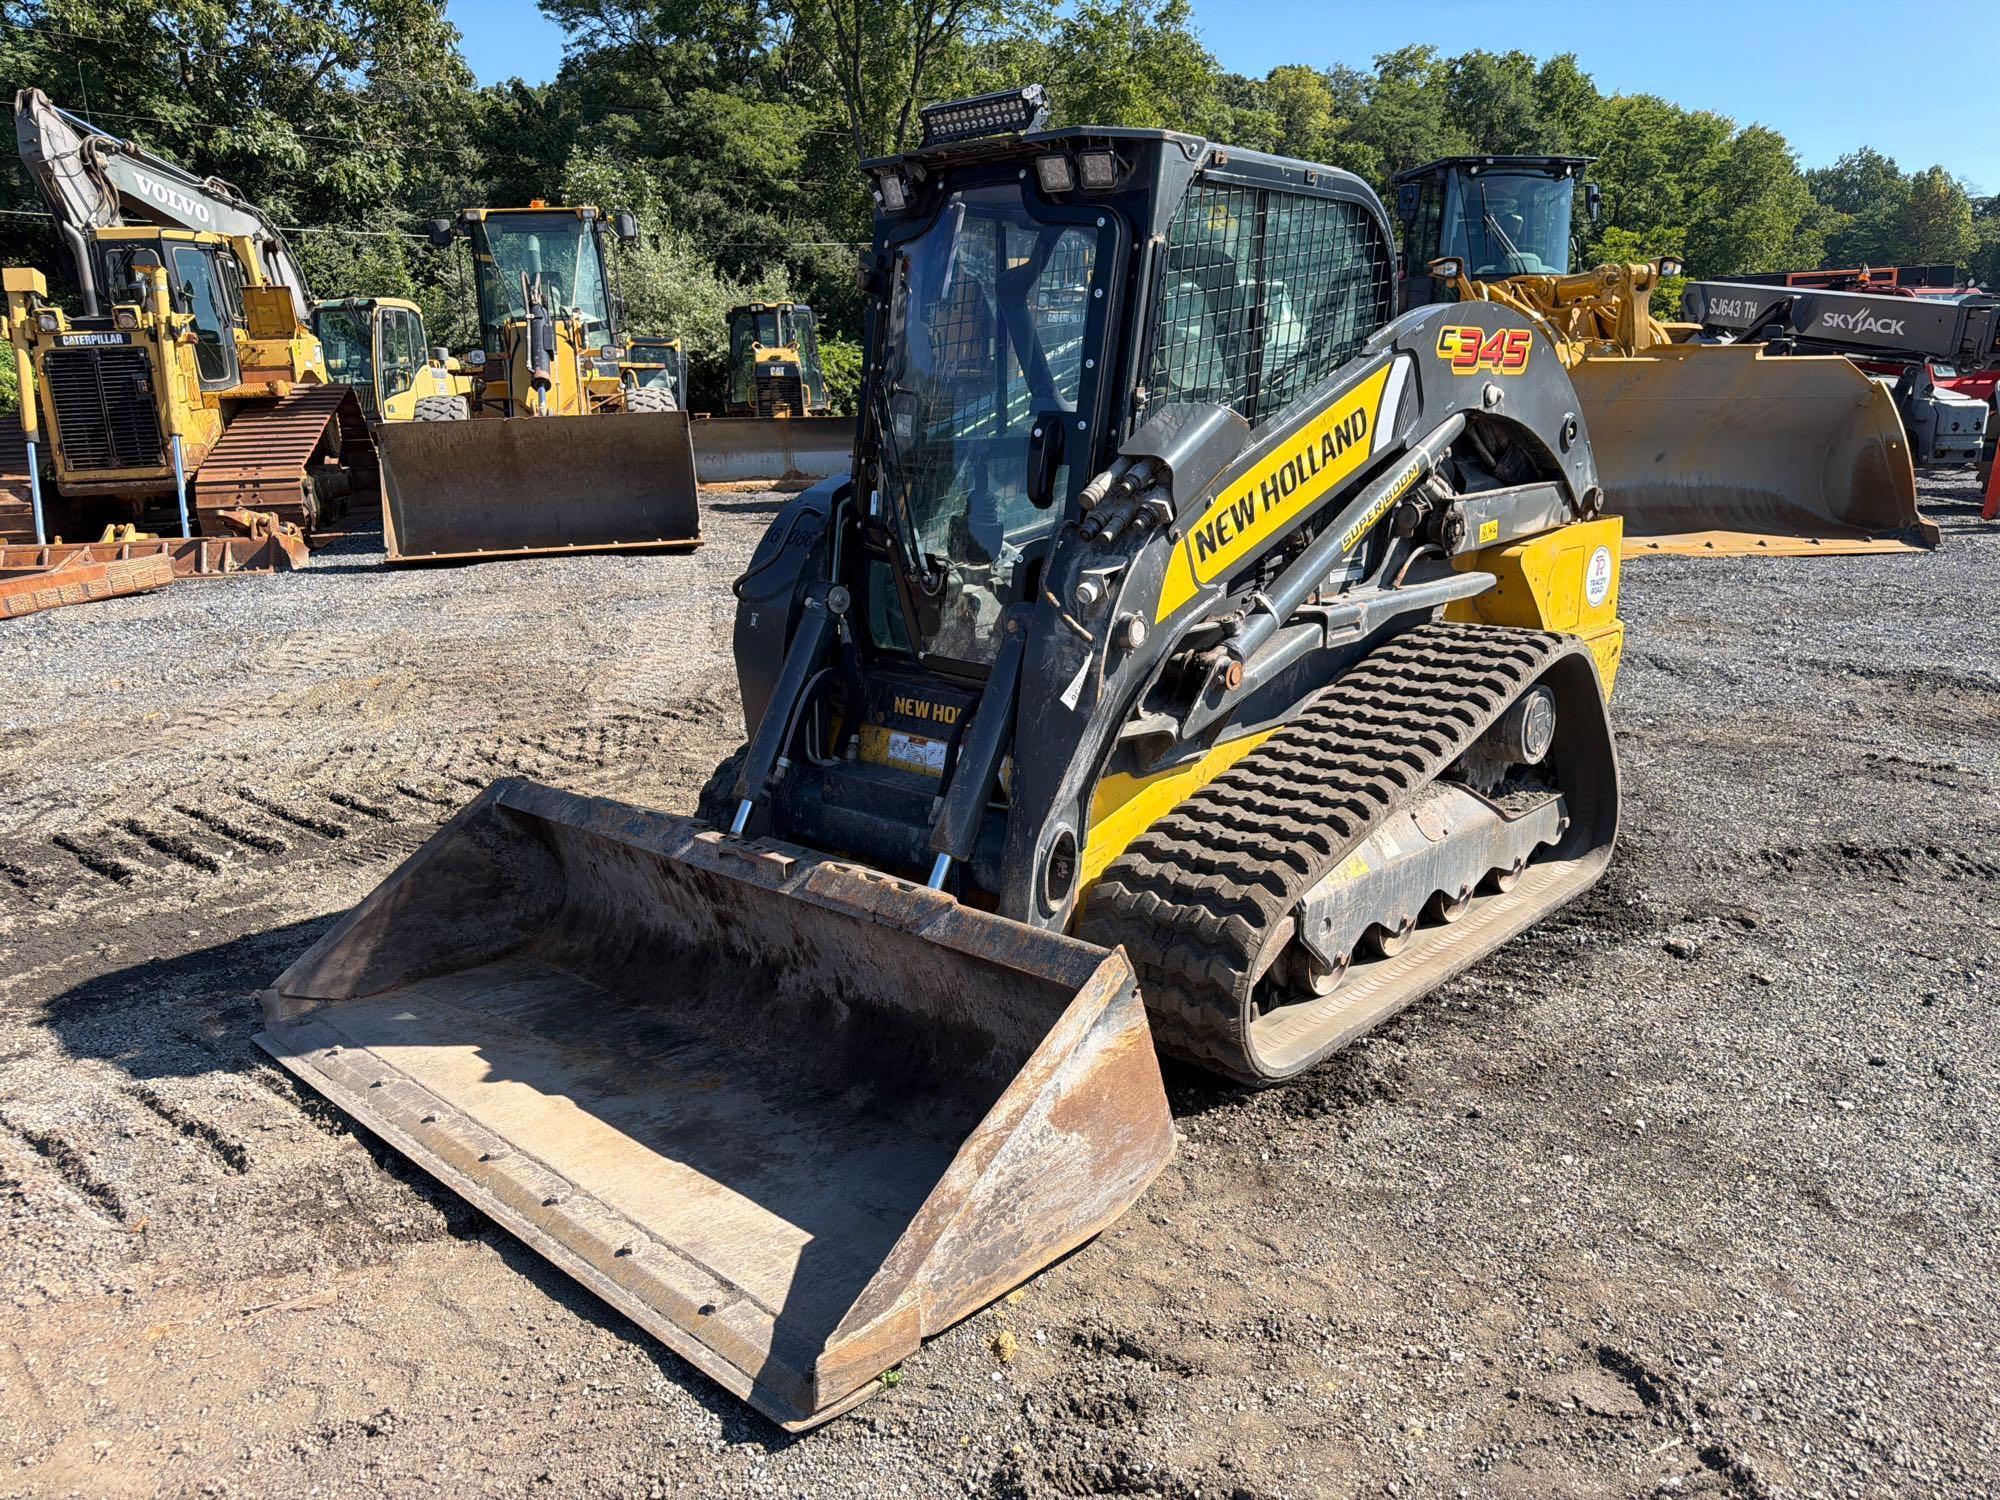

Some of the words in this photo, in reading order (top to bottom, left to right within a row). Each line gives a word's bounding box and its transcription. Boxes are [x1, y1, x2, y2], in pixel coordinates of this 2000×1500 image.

[132, 171, 210, 223] VOLVO
[1709, 297, 1742, 318] SJ643
[1743, 300, 1758, 320] TH
[1822, 307, 1906, 336] SKYJACK
[62, 333, 124, 346] CATERPILLAR
[1437, 327, 1532, 372] C345
[770, 366, 785, 377] CAT
[1194, 487, 1256, 563] NEW
[1259, 406, 1367, 514] HOLLAND
[1590, 586, 1604, 595] ROAD
[894, 696, 930, 719] NEW
